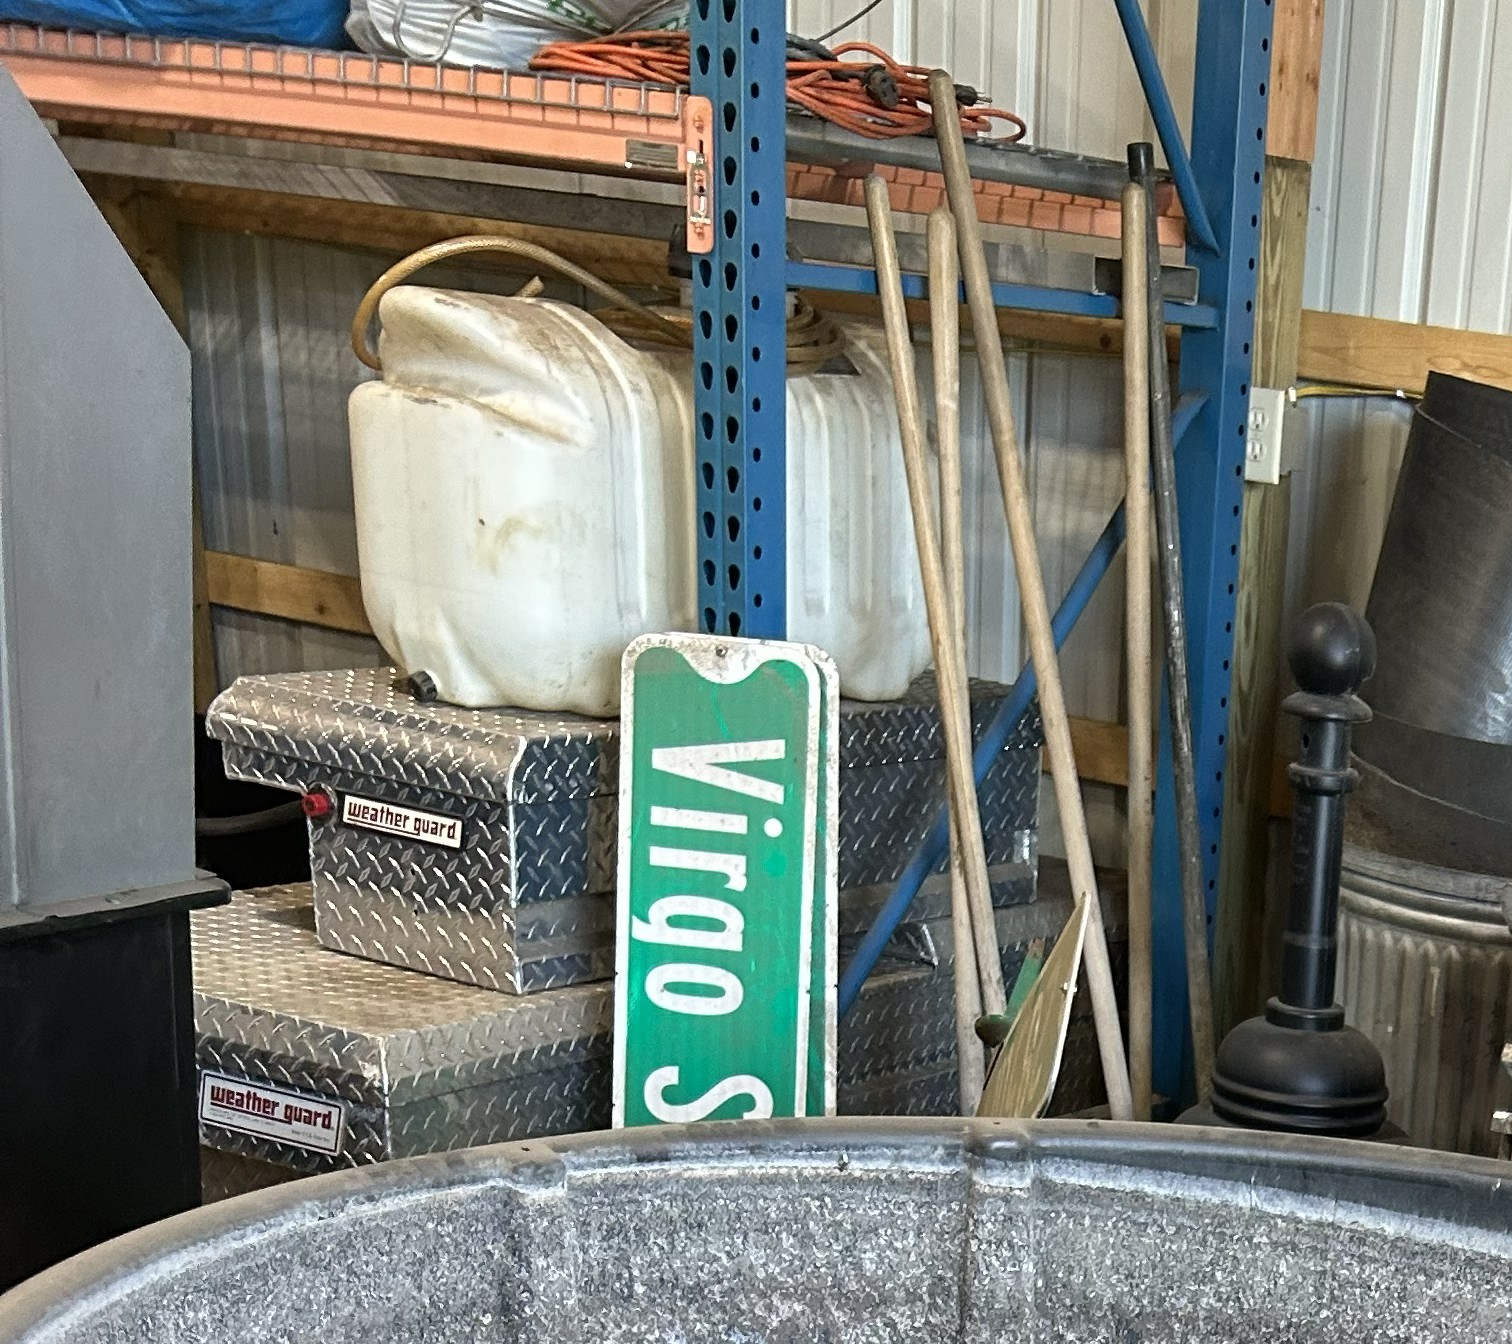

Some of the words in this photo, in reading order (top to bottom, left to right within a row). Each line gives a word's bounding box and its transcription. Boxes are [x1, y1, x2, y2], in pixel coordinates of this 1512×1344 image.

[348, 801, 410, 829] weather
[413, 817, 457, 840] guard
[631, 738, 786, 1017] Virgo
[210, 1085, 280, 1116] weather
[284, 1104, 333, 1130] guard
